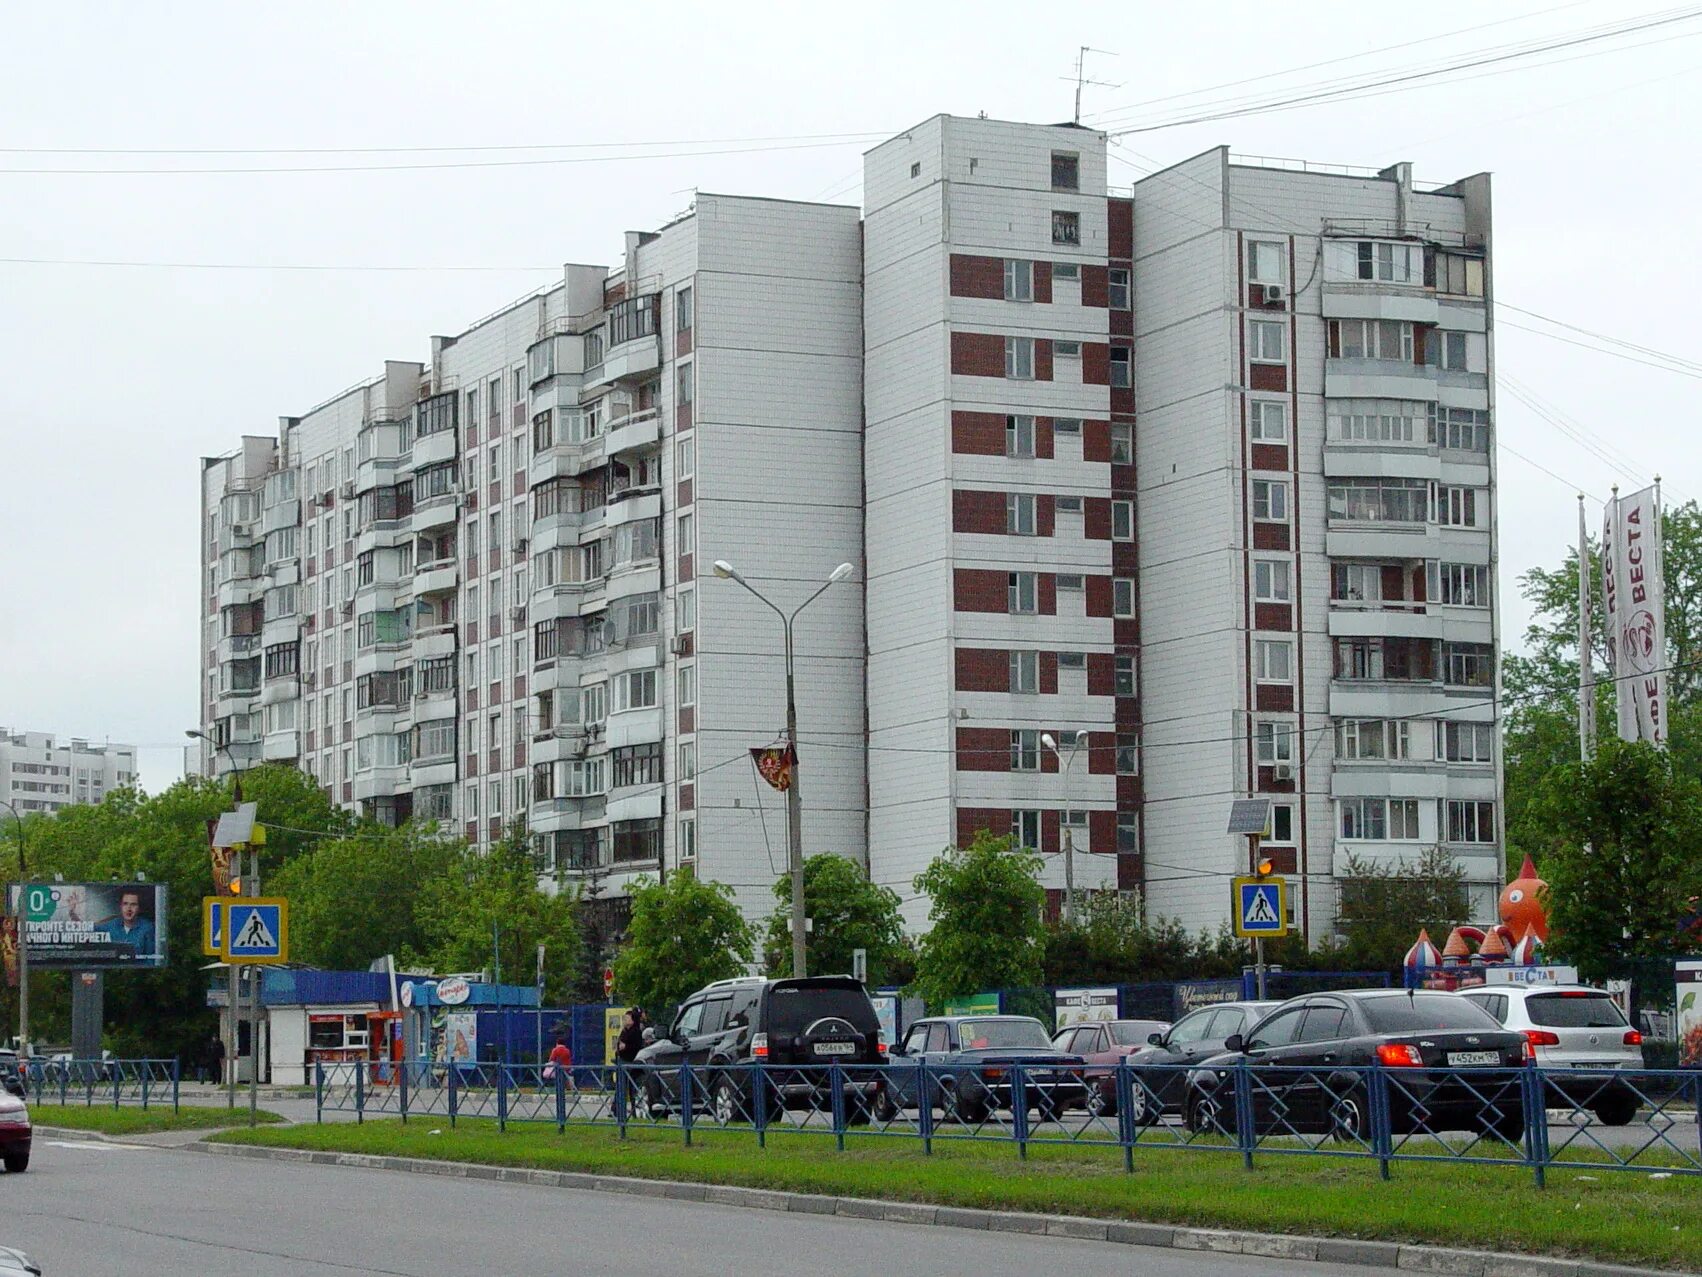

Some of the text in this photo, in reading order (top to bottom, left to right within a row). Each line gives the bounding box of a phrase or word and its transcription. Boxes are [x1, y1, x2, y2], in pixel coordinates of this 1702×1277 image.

[1628, 506, 1647, 604] ВЕСТА
[17, 921, 95, 932] ТКРОЙТЕ СЕЗОН
[17, 932, 112, 943] АЧНОГО ИНТЕРНЕТА
[1514, 967, 1548, 984] ВЕСТА
